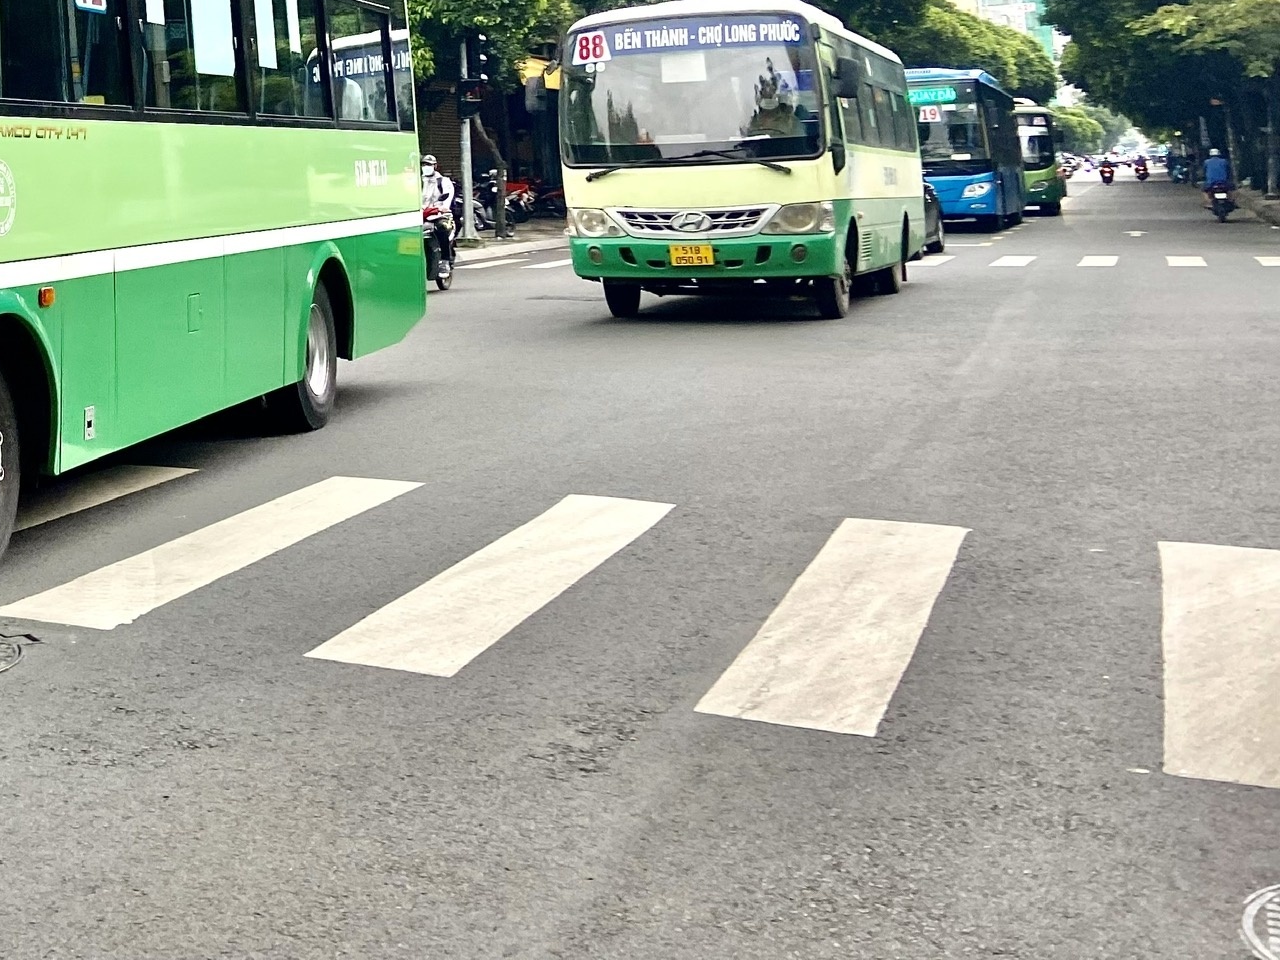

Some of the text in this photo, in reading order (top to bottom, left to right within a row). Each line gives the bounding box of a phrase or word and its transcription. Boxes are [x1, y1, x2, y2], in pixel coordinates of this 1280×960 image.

[614, 27, 642, 50] BẾN
[644, 25, 689, 48] THÀNH
[697, 23, 723, 47] CHỢ
[725, 23, 757, 43] LONG
[578, 34, 604, 61] 88
[921, 108, 937, 121] 19
[35, 127, 63, 140] CITY
[681, 246, 701, 255] 51B
